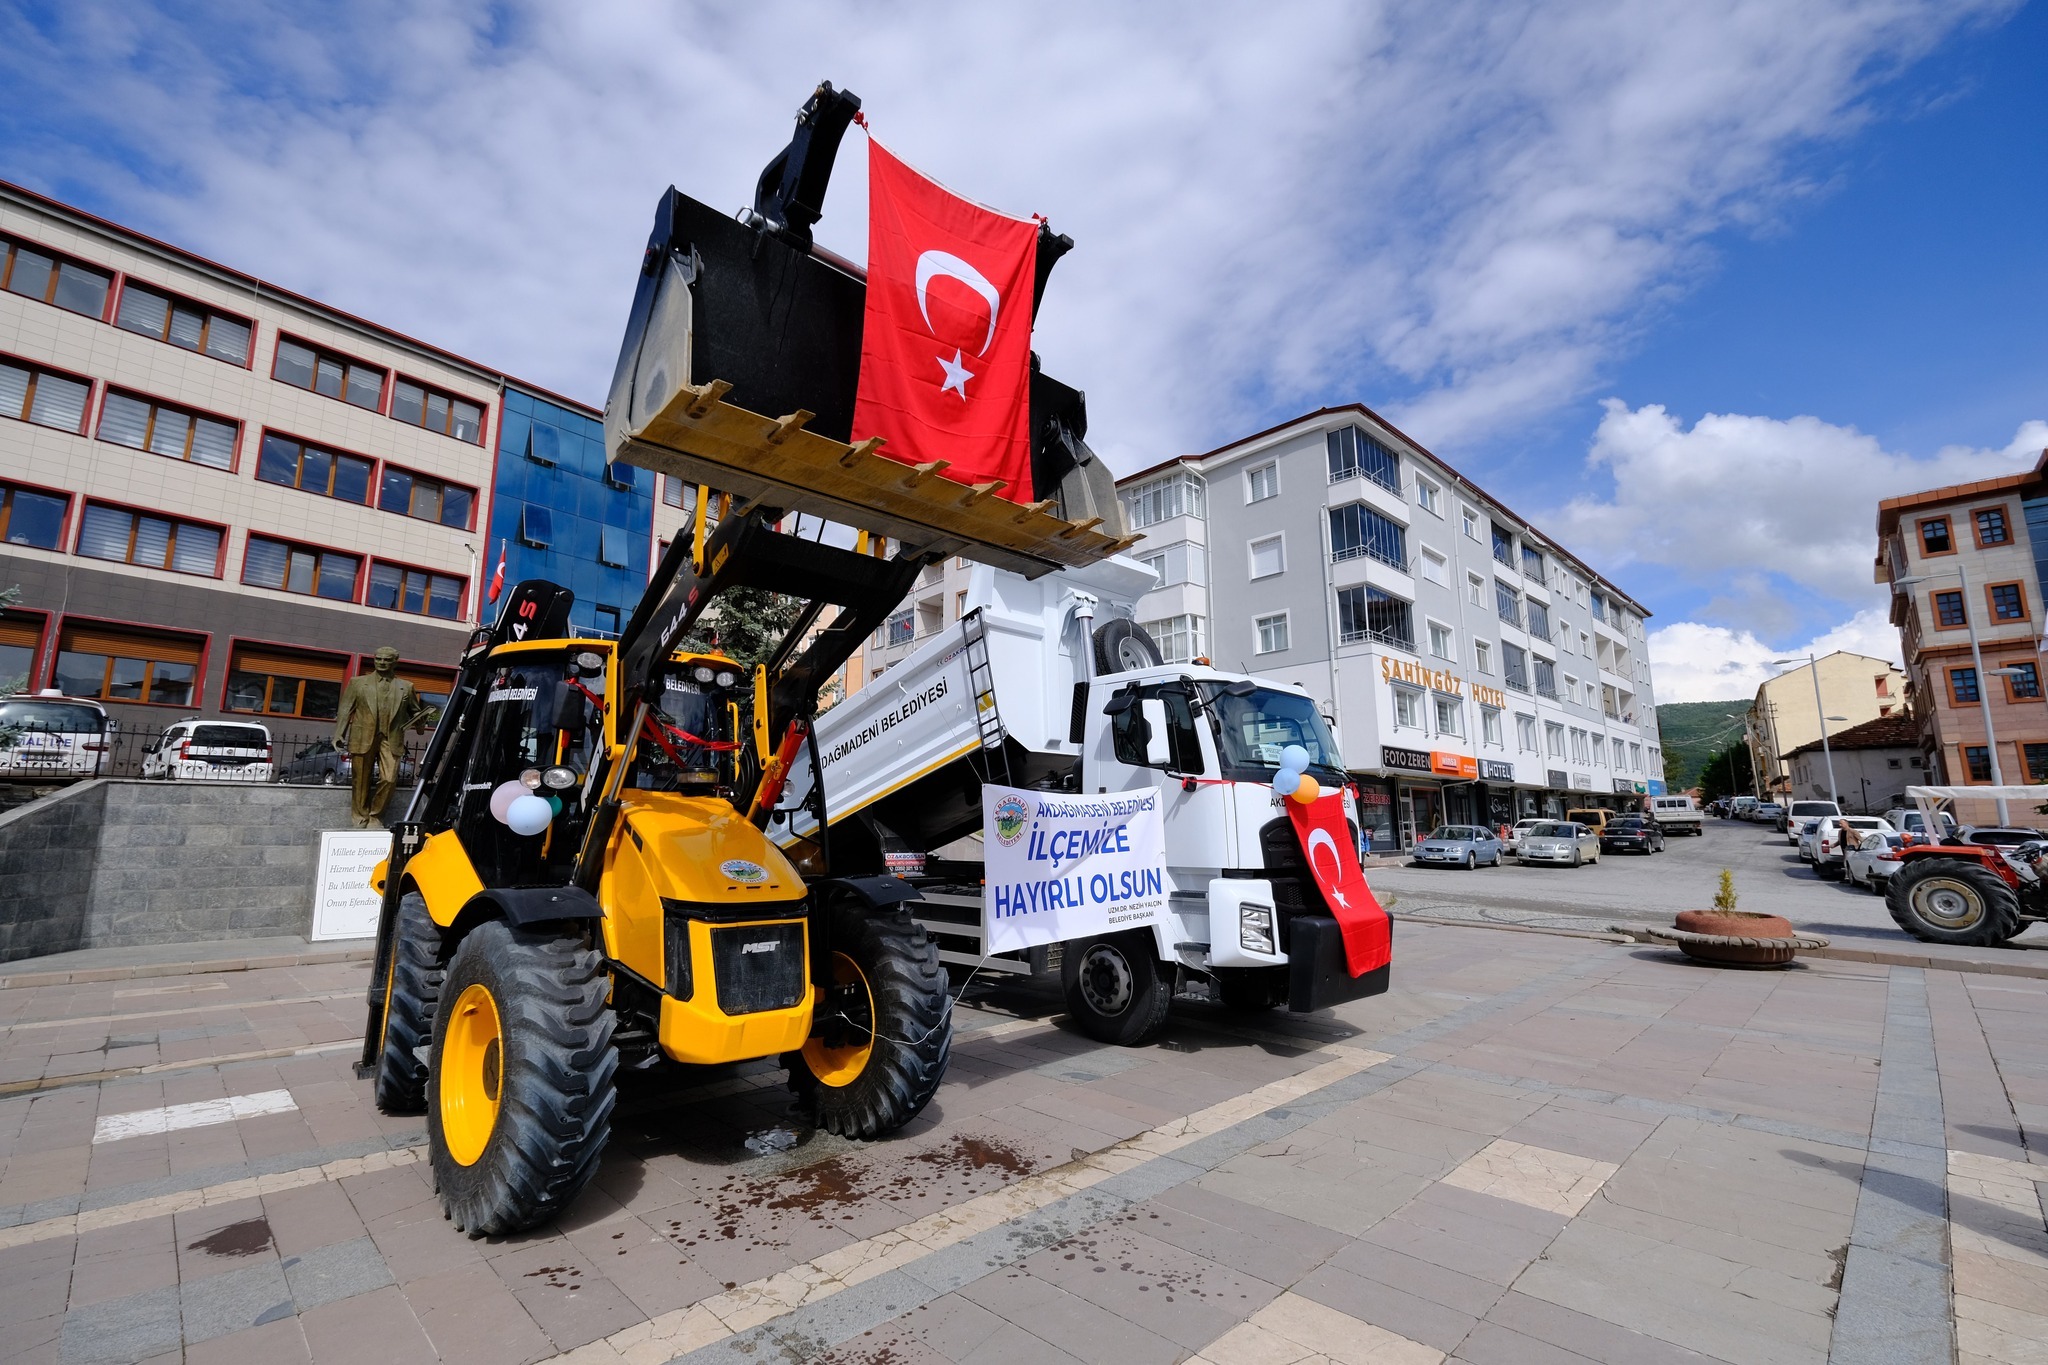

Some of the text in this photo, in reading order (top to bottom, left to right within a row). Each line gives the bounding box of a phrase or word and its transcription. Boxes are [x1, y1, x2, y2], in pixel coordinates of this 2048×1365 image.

[1381, 656, 1506, 710] ŞAHİNGÖZ HOTEL
[808, 676, 948, 778] ADAĞMADENİ BELEDİYESİ
[1384, 749, 1431, 769] FOTO ZEREN
[1487, 763, 1511, 779] HOTEL
[1036, 800, 1112, 818] AKDAĞMADENİ
[330, 847, 388, 858] Millete Efendilik
[1027, 820, 1130, 869] İLÇEMİZE
[329, 864, 356, 874] Hizmet
[327, 881, 339, 891] Bu
[339, 881, 365, 890] Millete
[995, 867, 1163, 919] HAYIRLI OLSUN
[348, 897, 378, 908] Efendisi
[1108, 911, 1155, 924] BELEDİYE BAŞKANI
[741, 940, 781, 955] MST
